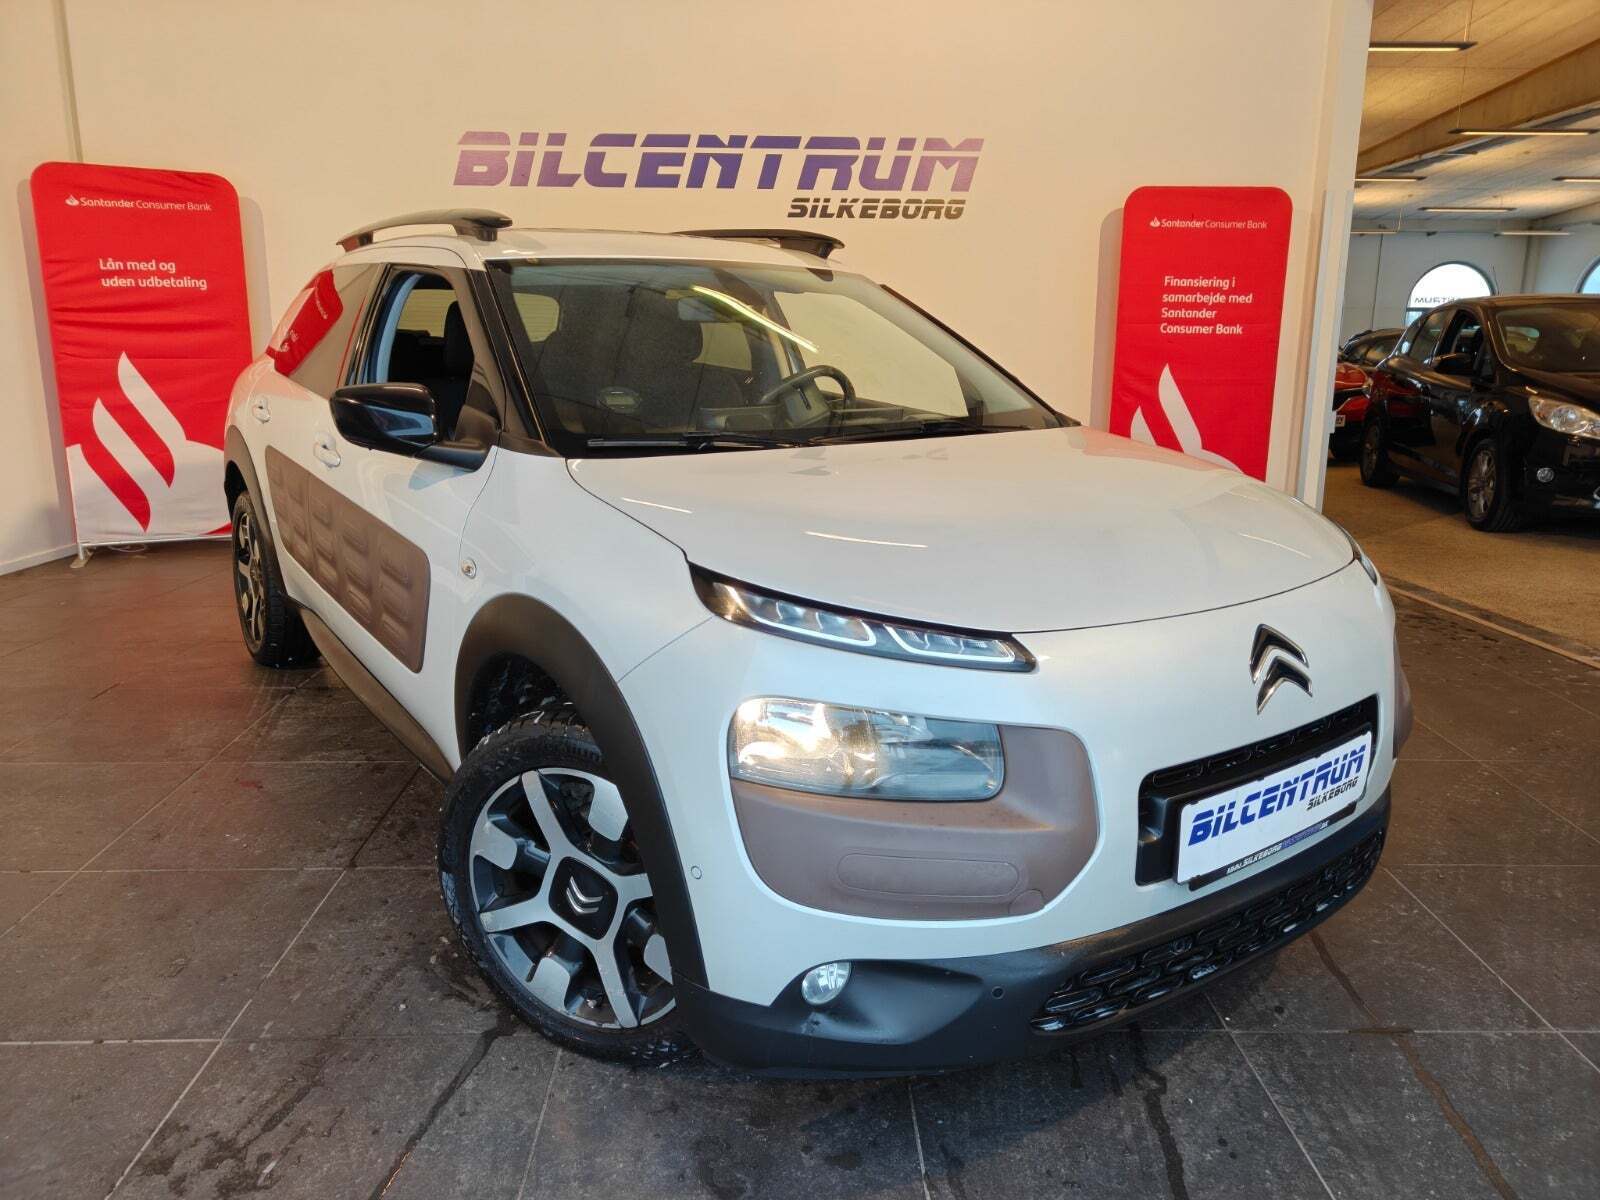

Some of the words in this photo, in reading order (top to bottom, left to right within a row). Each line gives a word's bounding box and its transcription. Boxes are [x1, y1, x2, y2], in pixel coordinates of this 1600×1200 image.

[452, 130, 984, 192] BILCENTRUM
[80, 196, 135, 209] Santander
[136, 200, 186, 210] Consumer
[187, 202, 212, 211] Bank
[787, 197, 966, 220] SILKEBORG
[1161, 218, 1204, 228] Santander
[1205, 219, 1246, 229] Consumer
[1247, 220, 1267, 229] Bank
[99, 257, 124, 271] Lån
[127, 259, 156, 271] med
[159, 261, 176, 273] og
[101, 275, 135, 287] uden
[139, 275, 208, 291] udbetaling
[1164, 275, 1230, 290] Finansiering
[1231, 276, 1236, 287] i
[1162, 292, 1226, 305] samarbejde
[1229, 293, 1253, 304] med
[1161, 307, 1217, 318] Santander
[1160, 323, 1214, 334] Consumer
[1216, 324, 1243, 335] Bank
[1188, 744, 1366, 846] BILCENTRUM
[1306, 775, 1359, 811] SILKEBORG
